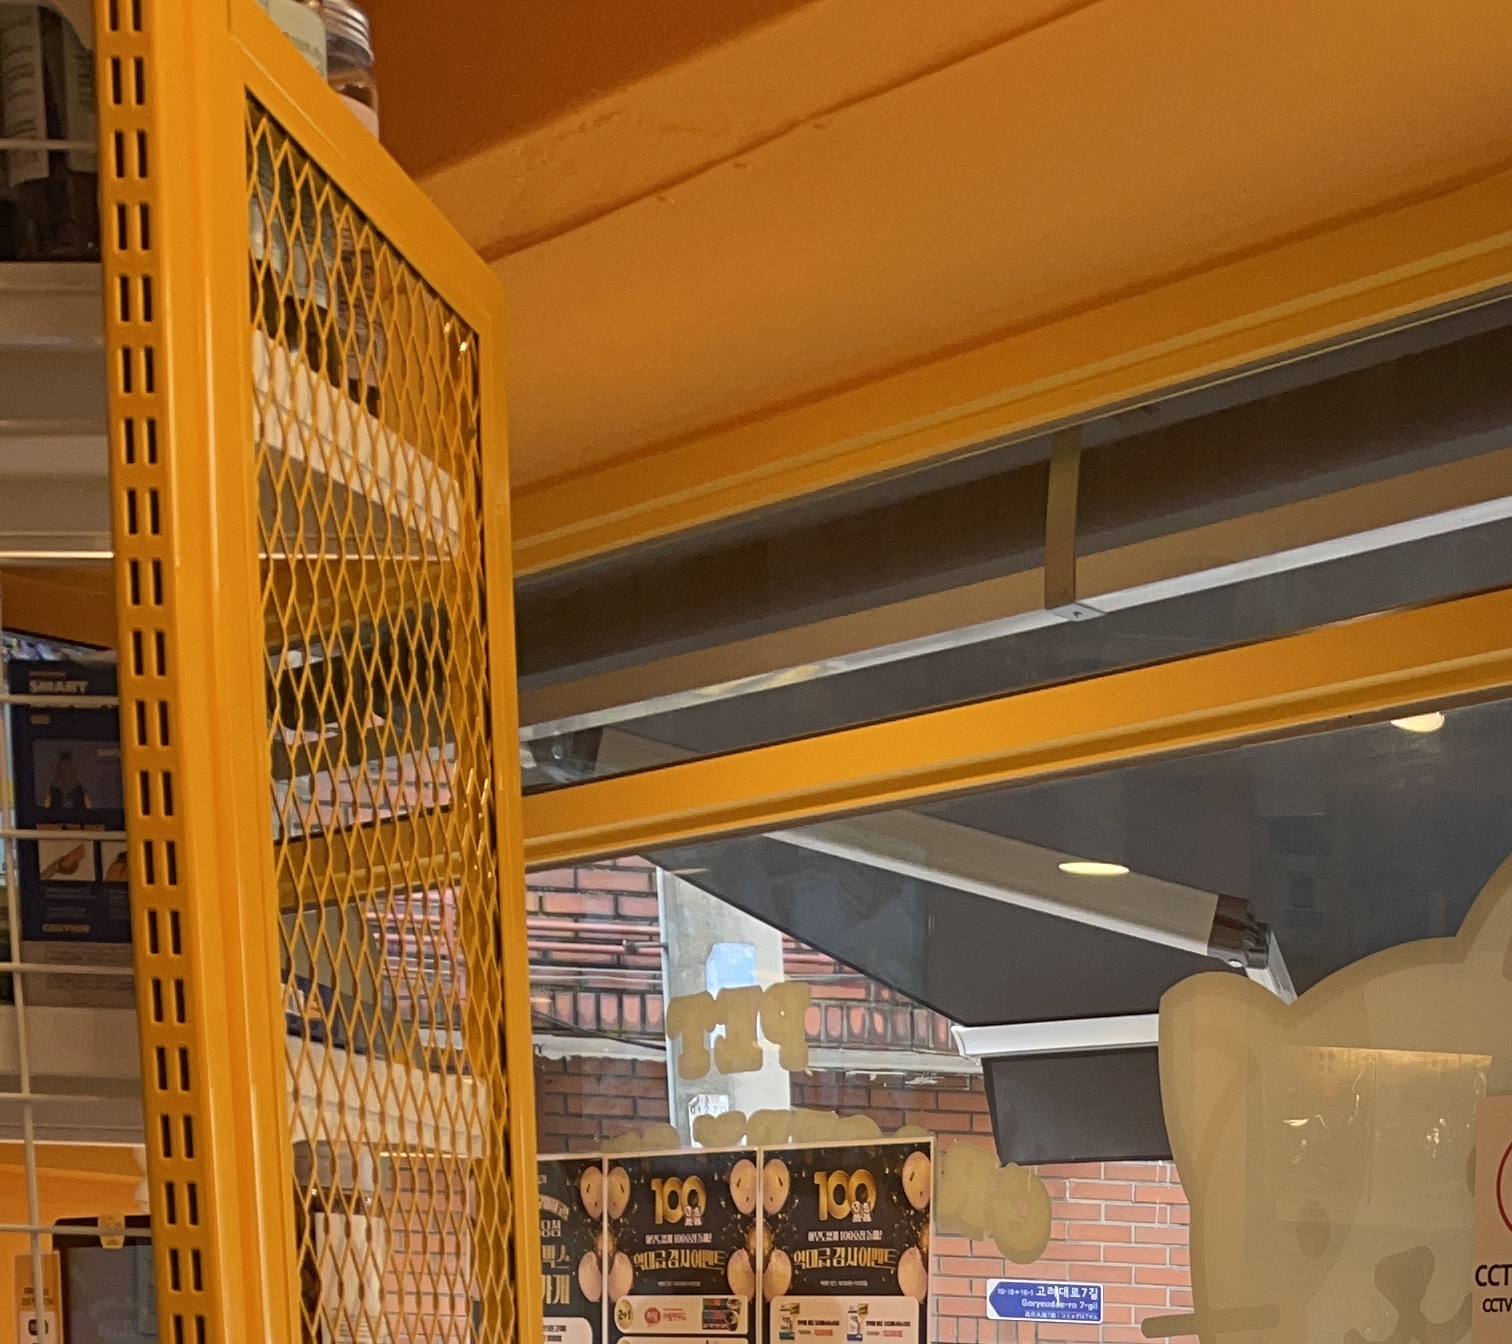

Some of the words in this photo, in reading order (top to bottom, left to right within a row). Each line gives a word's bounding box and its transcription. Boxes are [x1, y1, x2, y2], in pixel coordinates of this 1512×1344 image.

[650, 1175, 707, 1225] 100
[814, 1168, 877, 1221] 100
[618, 1309, 631, 1321] 2+1
[1482, 1297, 1512, 1312] CCTV
